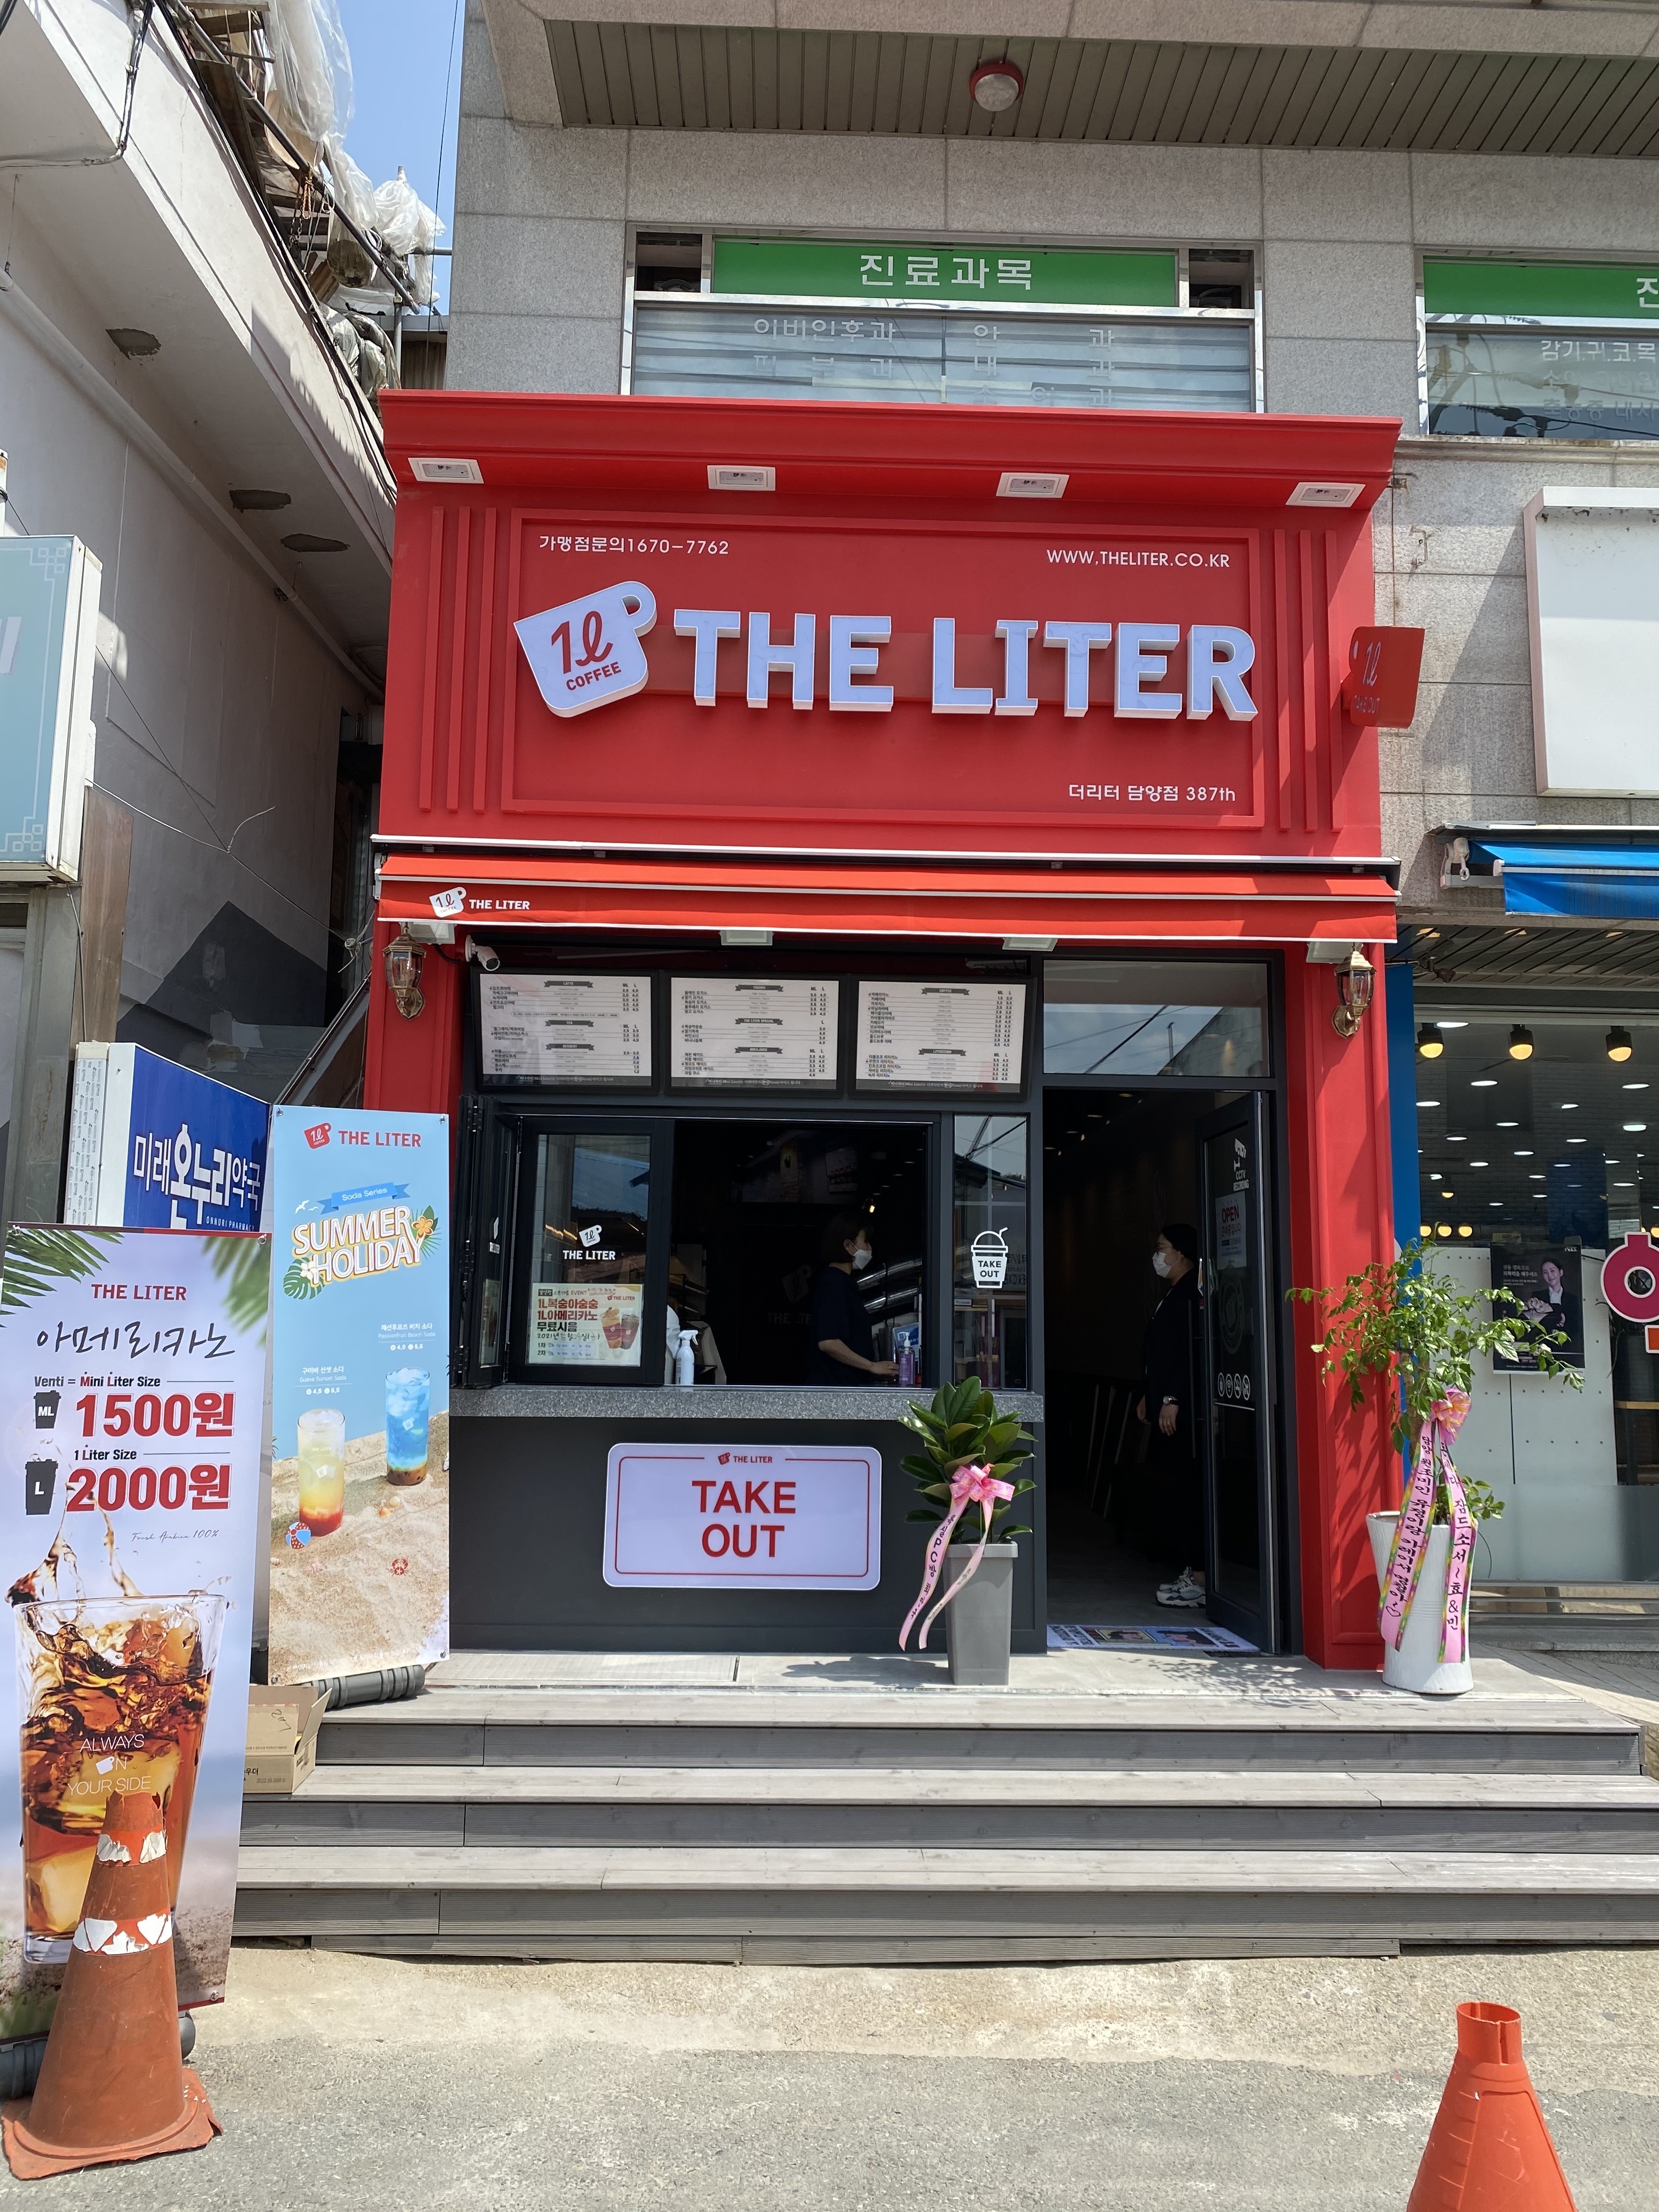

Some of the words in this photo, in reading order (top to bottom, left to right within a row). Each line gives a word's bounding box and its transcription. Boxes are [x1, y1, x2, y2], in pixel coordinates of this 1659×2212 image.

[860, 255, 1033, 291] 진료과목
[754, 319, 896, 343] 이비인후과
[1046, 549, 1231, 569] WWW.THELITER.CO.KR
[674, 608, 894, 712] THE
[932, 617, 1259, 721] LITER
[566, 661, 622, 691] COFFEE
[1069, 783, 1120, 802] 더리터
[1127, 784, 1178, 803] 담양점
[1186, 786, 1236, 803] 387th
[469, 899, 493, 909] THE
[495, 900, 531, 910] LITER
[338, 1130, 370, 1145] THE
[376, 1132, 421, 1147] LITER
[1235, 1169, 1246, 1181] CCTV
[342, 1192, 362, 1201] Soda
[363, 1187, 388, 1198] Series
[206, 1216, 227, 1228] ONNURI
[1221, 1203, 1240, 1224] OPEN
[295, 1205, 415, 1255] SUMMER
[311, 1235, 423, 1286] HOLIDAY
[563, 1250, 583, 1260] THE
[585, 1250, 616, 1260] LITER
[978, 1260, 1002, 1268] TAKE
[980, 1270, 1000, 1278] OUT
[91, 1284, 127, 1300] THE
[133, 1286, 187, 1301] LITER
[537, 1310, 598, 1321] 1L아메리카노
[537, 1321, 578, 1333] 무료시음
[37, 1321, 236, 1359] 아메리카노
[34, 1376, 64, 1387] Venti
[80, 1376, 104, 1387] Mini
[107, 1375, 134, 1387] Liter
[137, 1375, 161, 1387] Size
[38, 1406, 54, 1417] ML
[76, 1392, 236, 1438] 1500원
[74, 1450, 79, 1460] 1
[82, 1449, 110, 1461] Liter
[113, 1449, 137, 1460] Size
[733, 1455, 749, 1464] THE
[750, 1455, 773, 1464] LITER
[34, 1482, 44, 1496] L
[66, 1463, 232, 1513] 2000원
[692, 1480, 797, 1514] TAKE
[193, 1529, 219, 1539] 100%
[702, 1523, 785, 1558] OUT
[80, 1733, 145, 1753] ALWAYS
[244, 1768, 259, 1776] 우더
[67, 1778, 112, 1797] YOUR
[114, 1776, 151, 1793] SIDE
